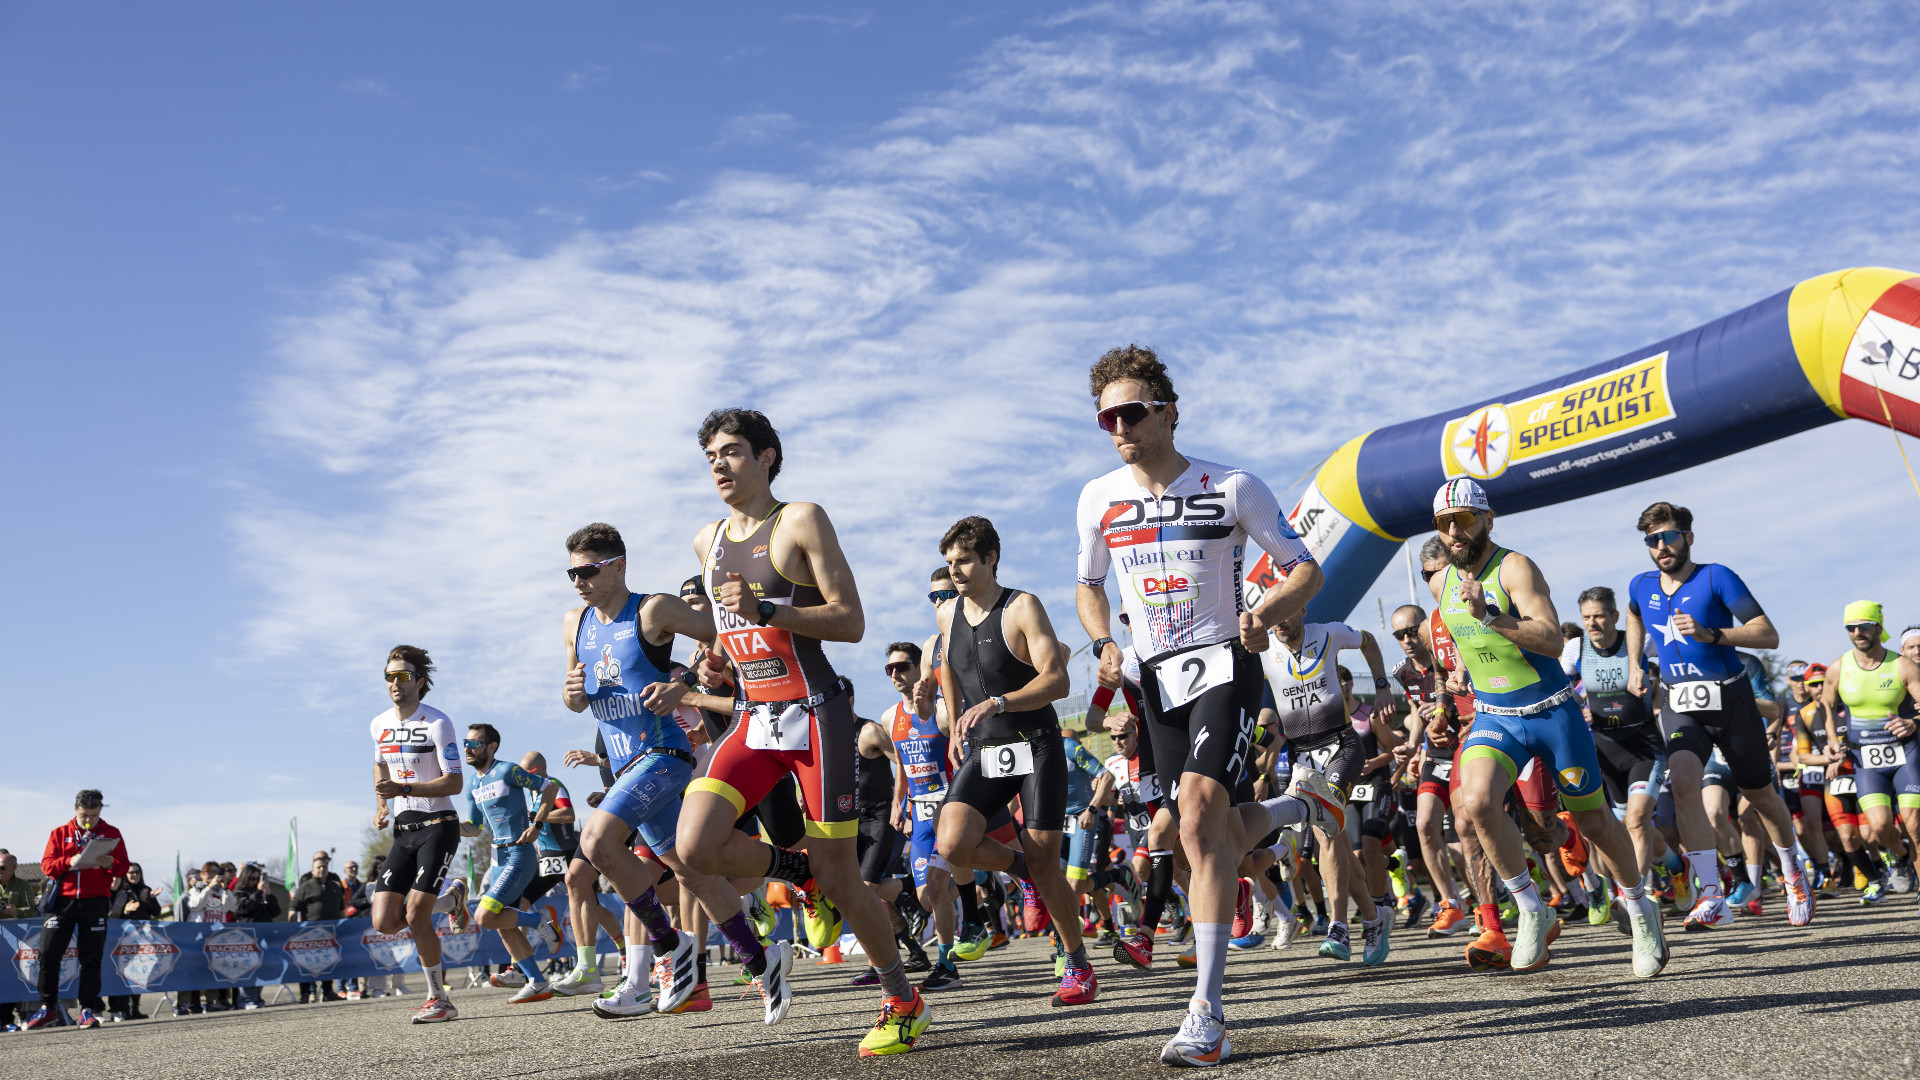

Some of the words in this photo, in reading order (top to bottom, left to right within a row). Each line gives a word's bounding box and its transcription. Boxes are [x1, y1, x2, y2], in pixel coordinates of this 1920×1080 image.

[1528, 400, 1557, 424] df
[1561, 367, 1655, 414] SPORT
[1519, 391, 1655, 450] SPECIALIST
[1529, 430, 1677, 479] www.df-sportspecialist.it
[1121, 547, 1205, 574] planven
[1143, 574, 1189, 594] Dole
[728, 631, 772, 656] ITA
[1477, 651, 1500, 664] ITA
[746, 667, 780, 679] REGGIANO
[1181, 657, 1208, 697] 2
[1595, 667, 1624, 682] SCUOR
[1669, 662, 1704, 677] ITA
[1282, 677, 1328, 698] GENTILE
[1601, 681, 1619, 691] ITA
[1290, 693, 1322, 711] ITA
[1677, 684, 1711, 709] 49
[609, 731, 633, 758] ITA
[900, 740, 931, 755] PEZZATI
[908, 753, 927, 764] ITA
[998, 747, 1016, 774] 9
[1869, 745, 1897, 766] 89
[396, 768, 416, 779] Dole
[1806, 772, 1822, 783] 10
[1356, 787, 1367, 799] 9
[923, 800, 936, 818] 5
[543, 858, 564, 875] 23
[288, 939, 333, 950] PIACENZA
[366, 932, 409, 943] PIACENZA
[118, 944, 173, 955] PIACENZA
[209, 944, 254, 953] PIACENZA
